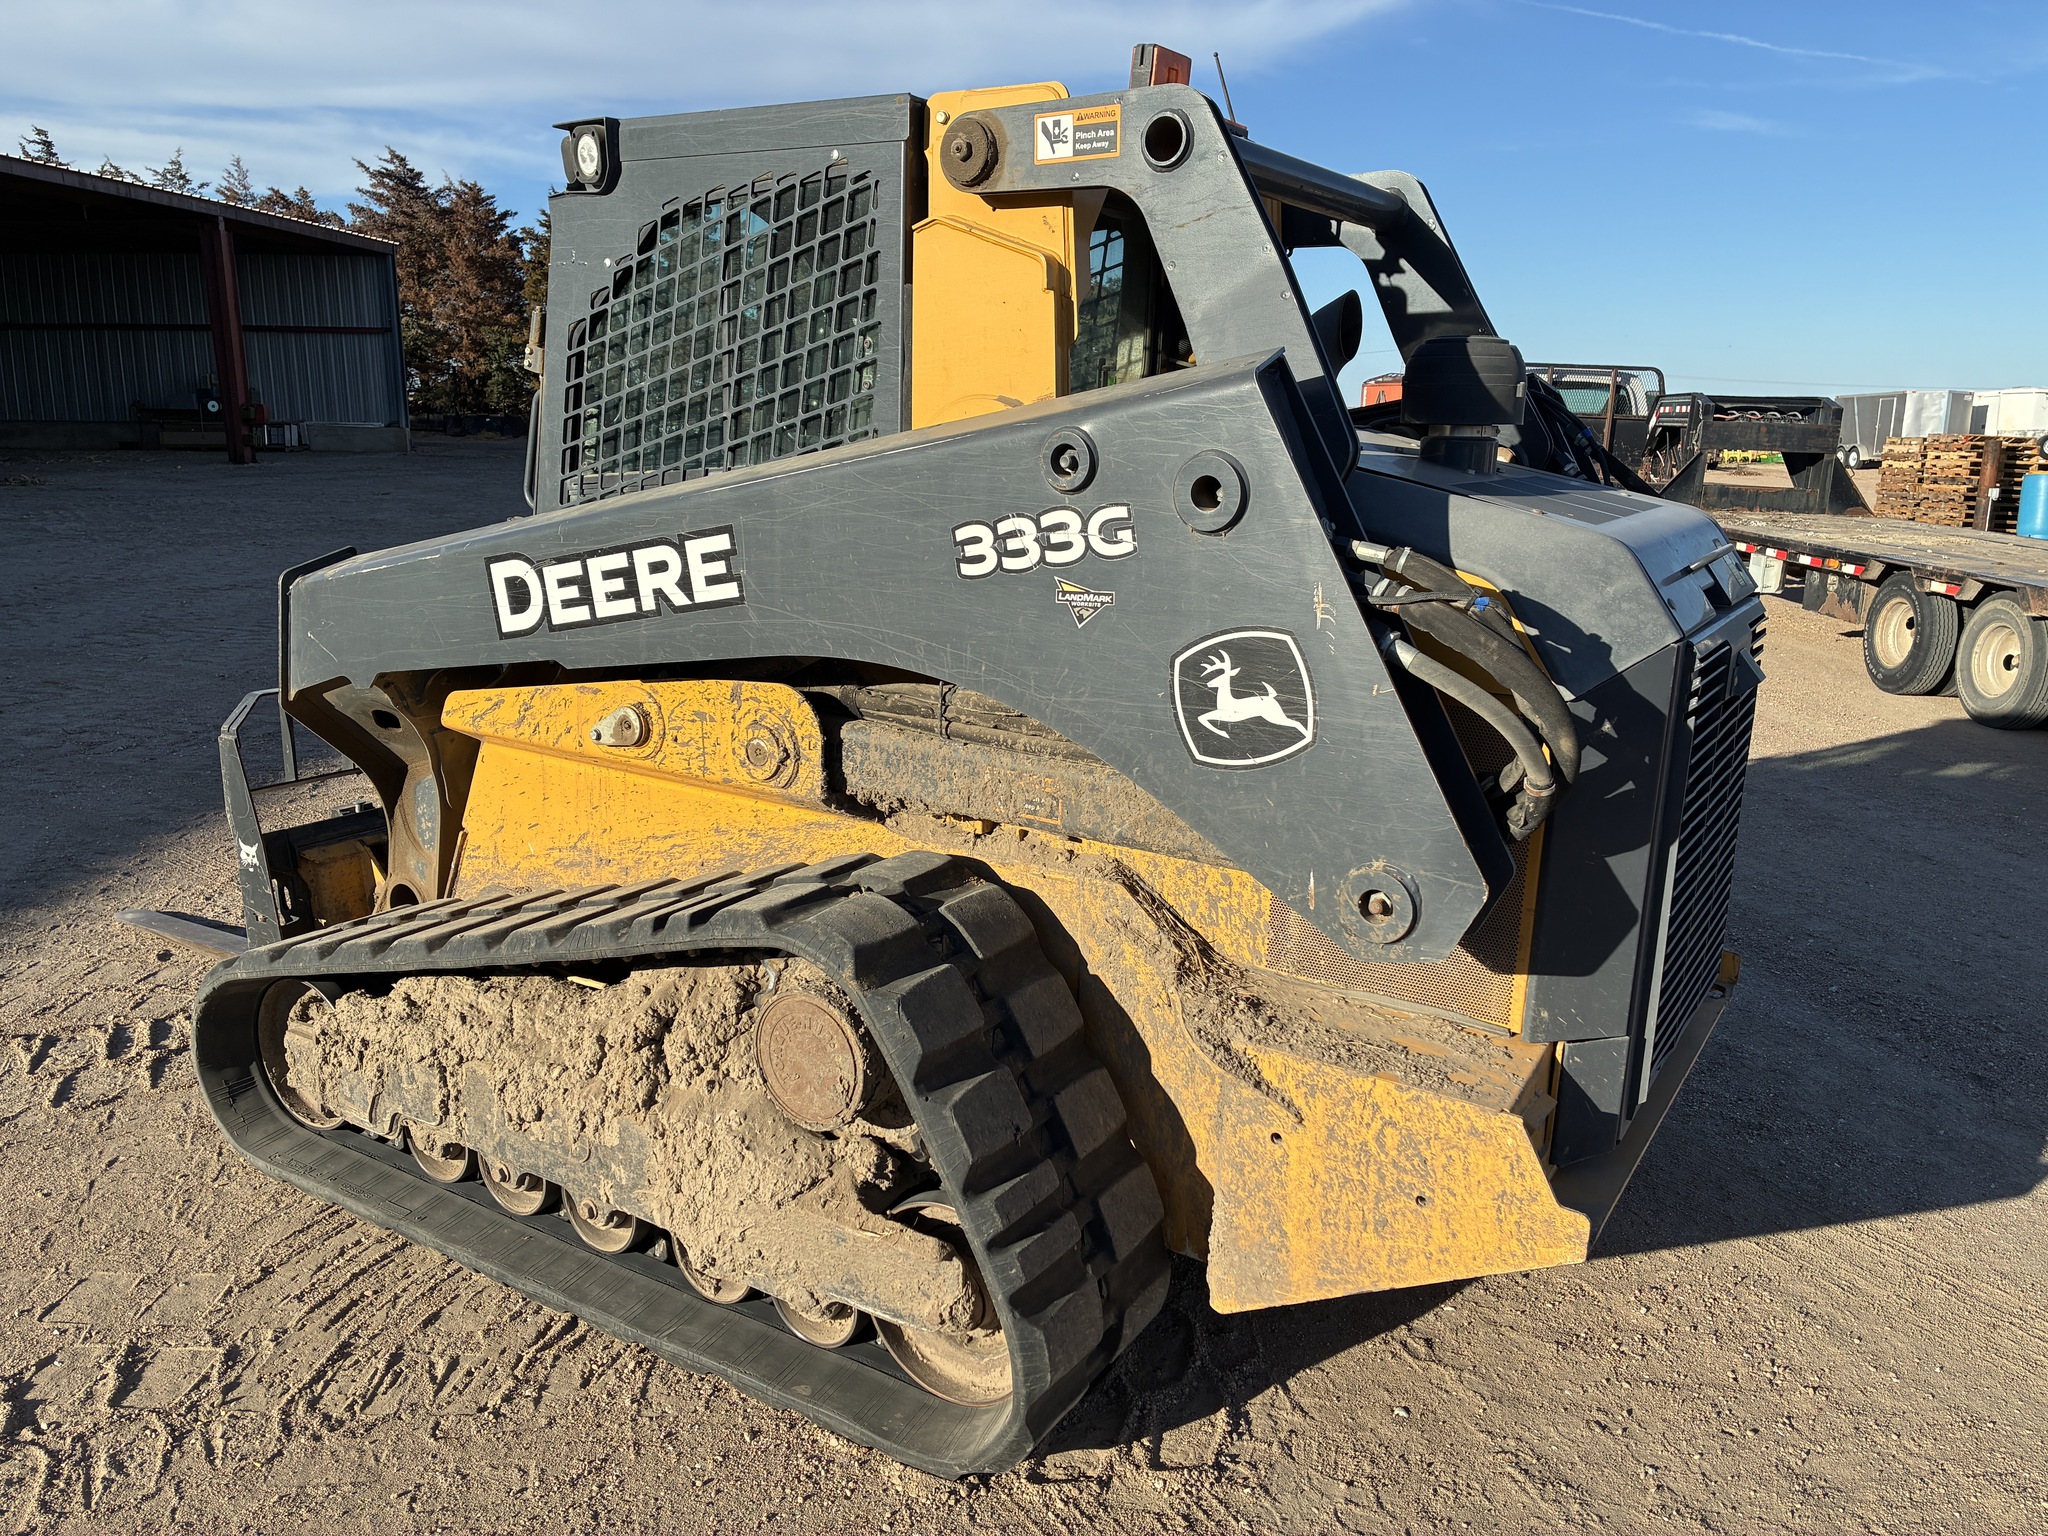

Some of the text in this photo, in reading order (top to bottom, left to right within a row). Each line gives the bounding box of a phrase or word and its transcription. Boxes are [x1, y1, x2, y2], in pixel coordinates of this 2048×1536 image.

[1083, 110, 1116, 120] WARNING
[1075, 129, 1114, 139] Pinch Area
[1075, 142, 1091, 150] Keep
[953, 504, 1136, 578] 333G
[489, 532, 740, 634] DEERE
